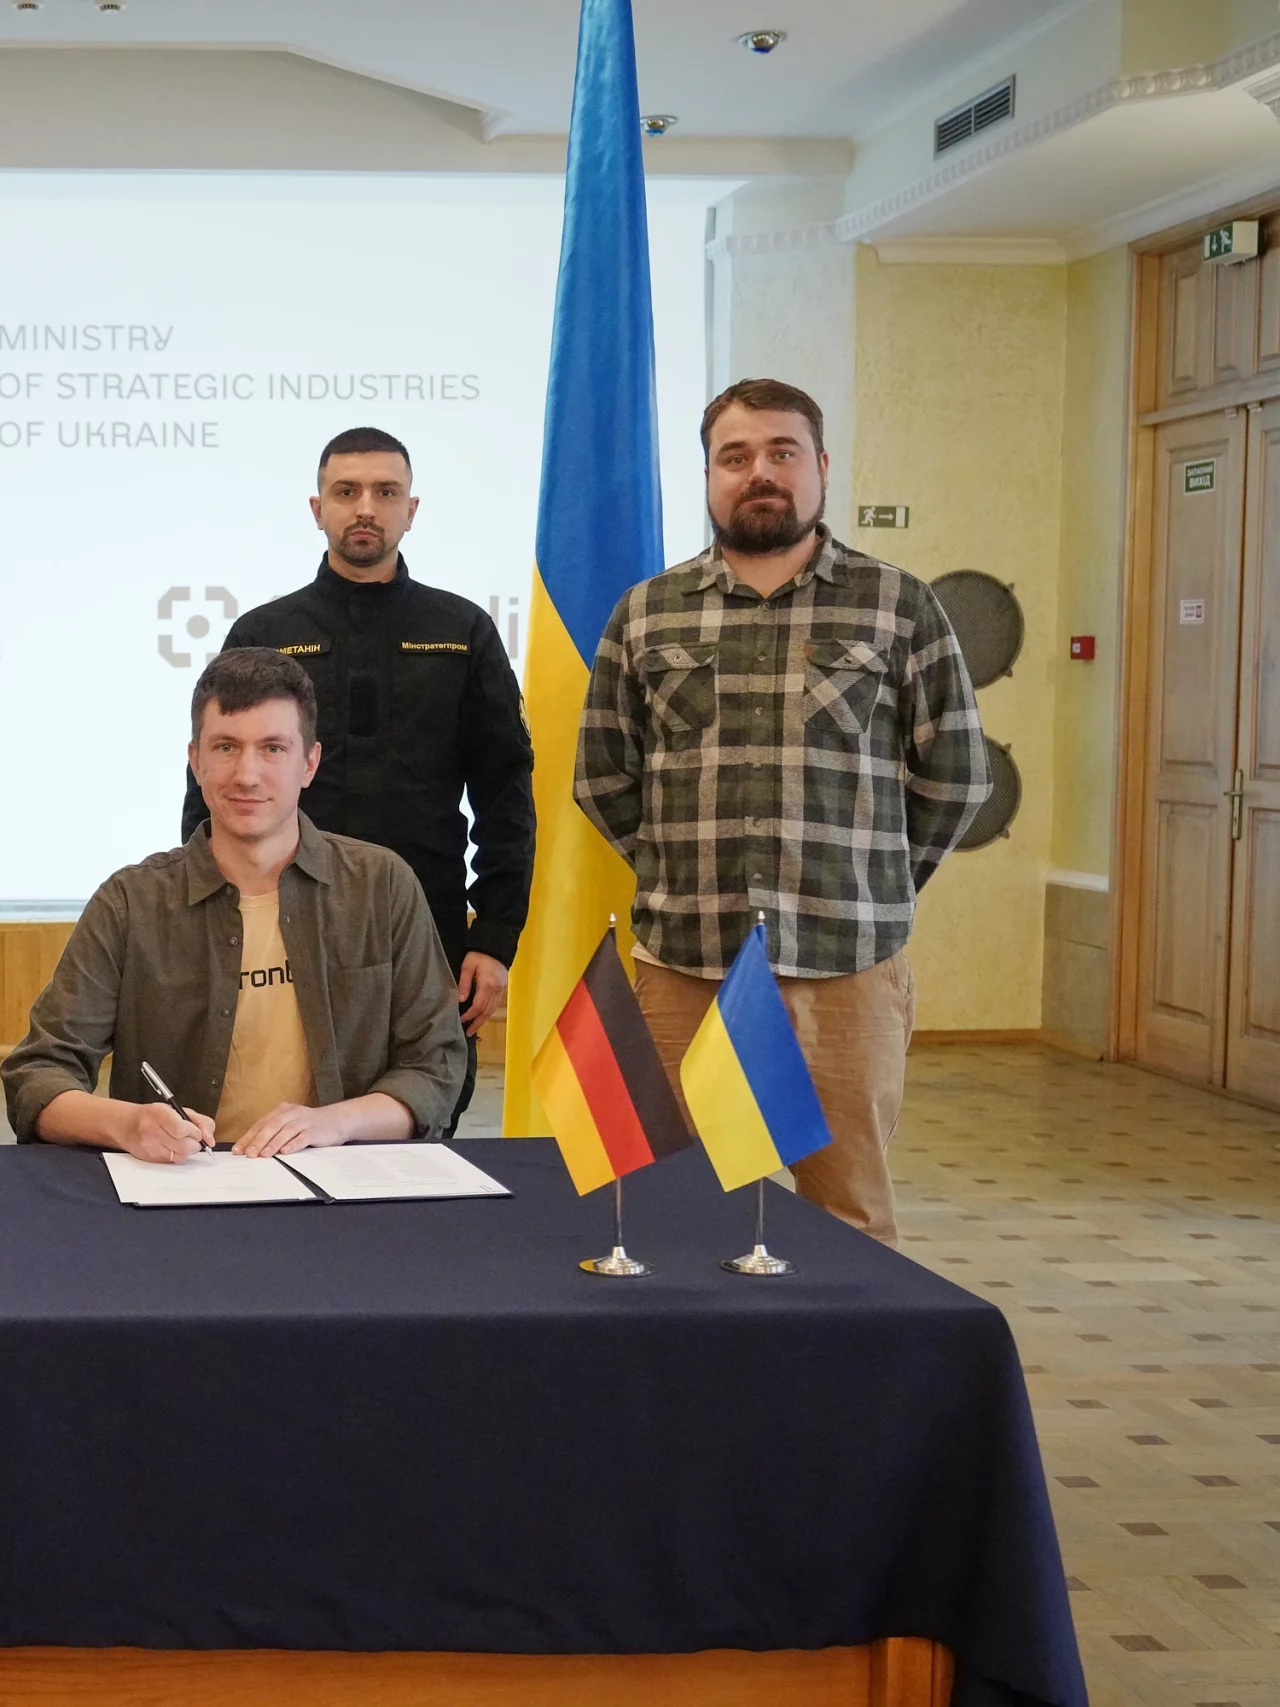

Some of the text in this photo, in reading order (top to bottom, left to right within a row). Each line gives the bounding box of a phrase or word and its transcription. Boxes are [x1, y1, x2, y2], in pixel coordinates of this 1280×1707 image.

[56, 373, 255, 400] STRATEGIC
[268, 373, 480, 400] INDUSTRIES
[57, 421, 219, 448] UKRAINE
[275, 644, 321, 655] МЕТАНІН
